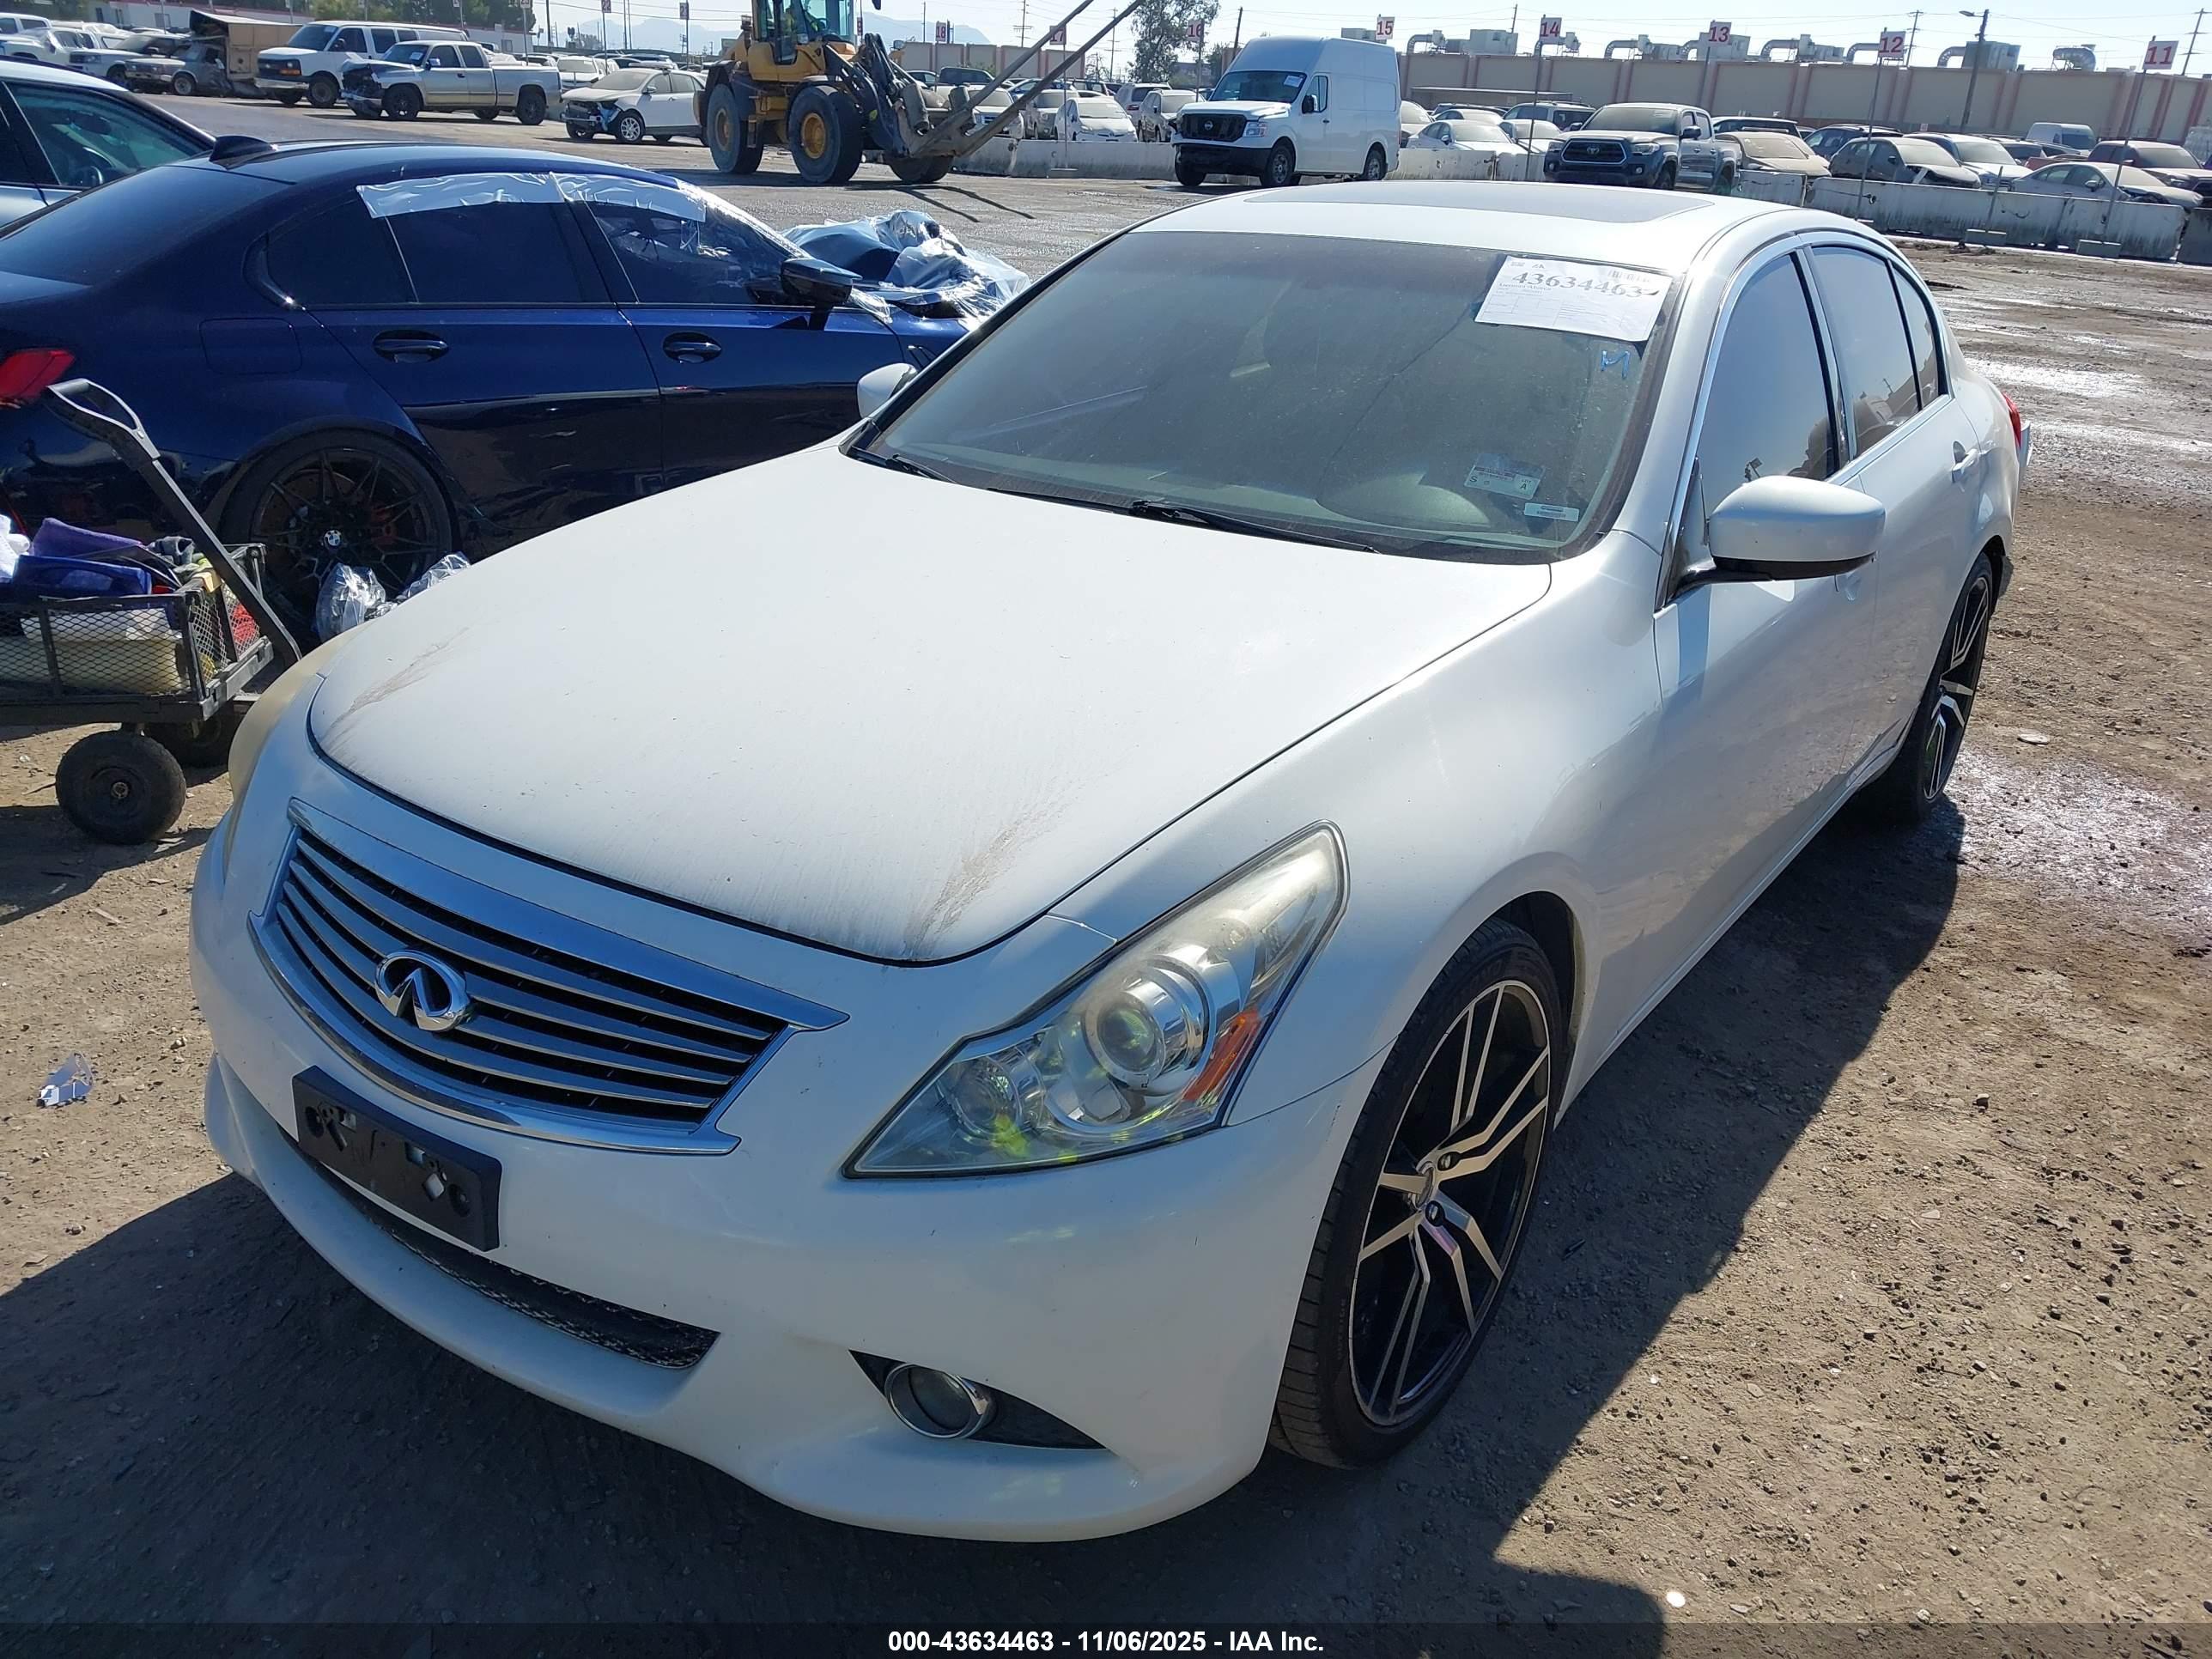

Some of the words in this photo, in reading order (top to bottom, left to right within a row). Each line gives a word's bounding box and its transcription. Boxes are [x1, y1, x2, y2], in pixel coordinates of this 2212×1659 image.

[936, 26, 946, 39] 18
[1188, 24, 1202, 37] 16
[1377, 21, 1394, 35] 15
[1540, 21, 1560, 37] 14
[1709, 27, 1729, 42] 13
[1880, 36, 1904, 52] 12
[2144, 46, 2172, 64] 11
